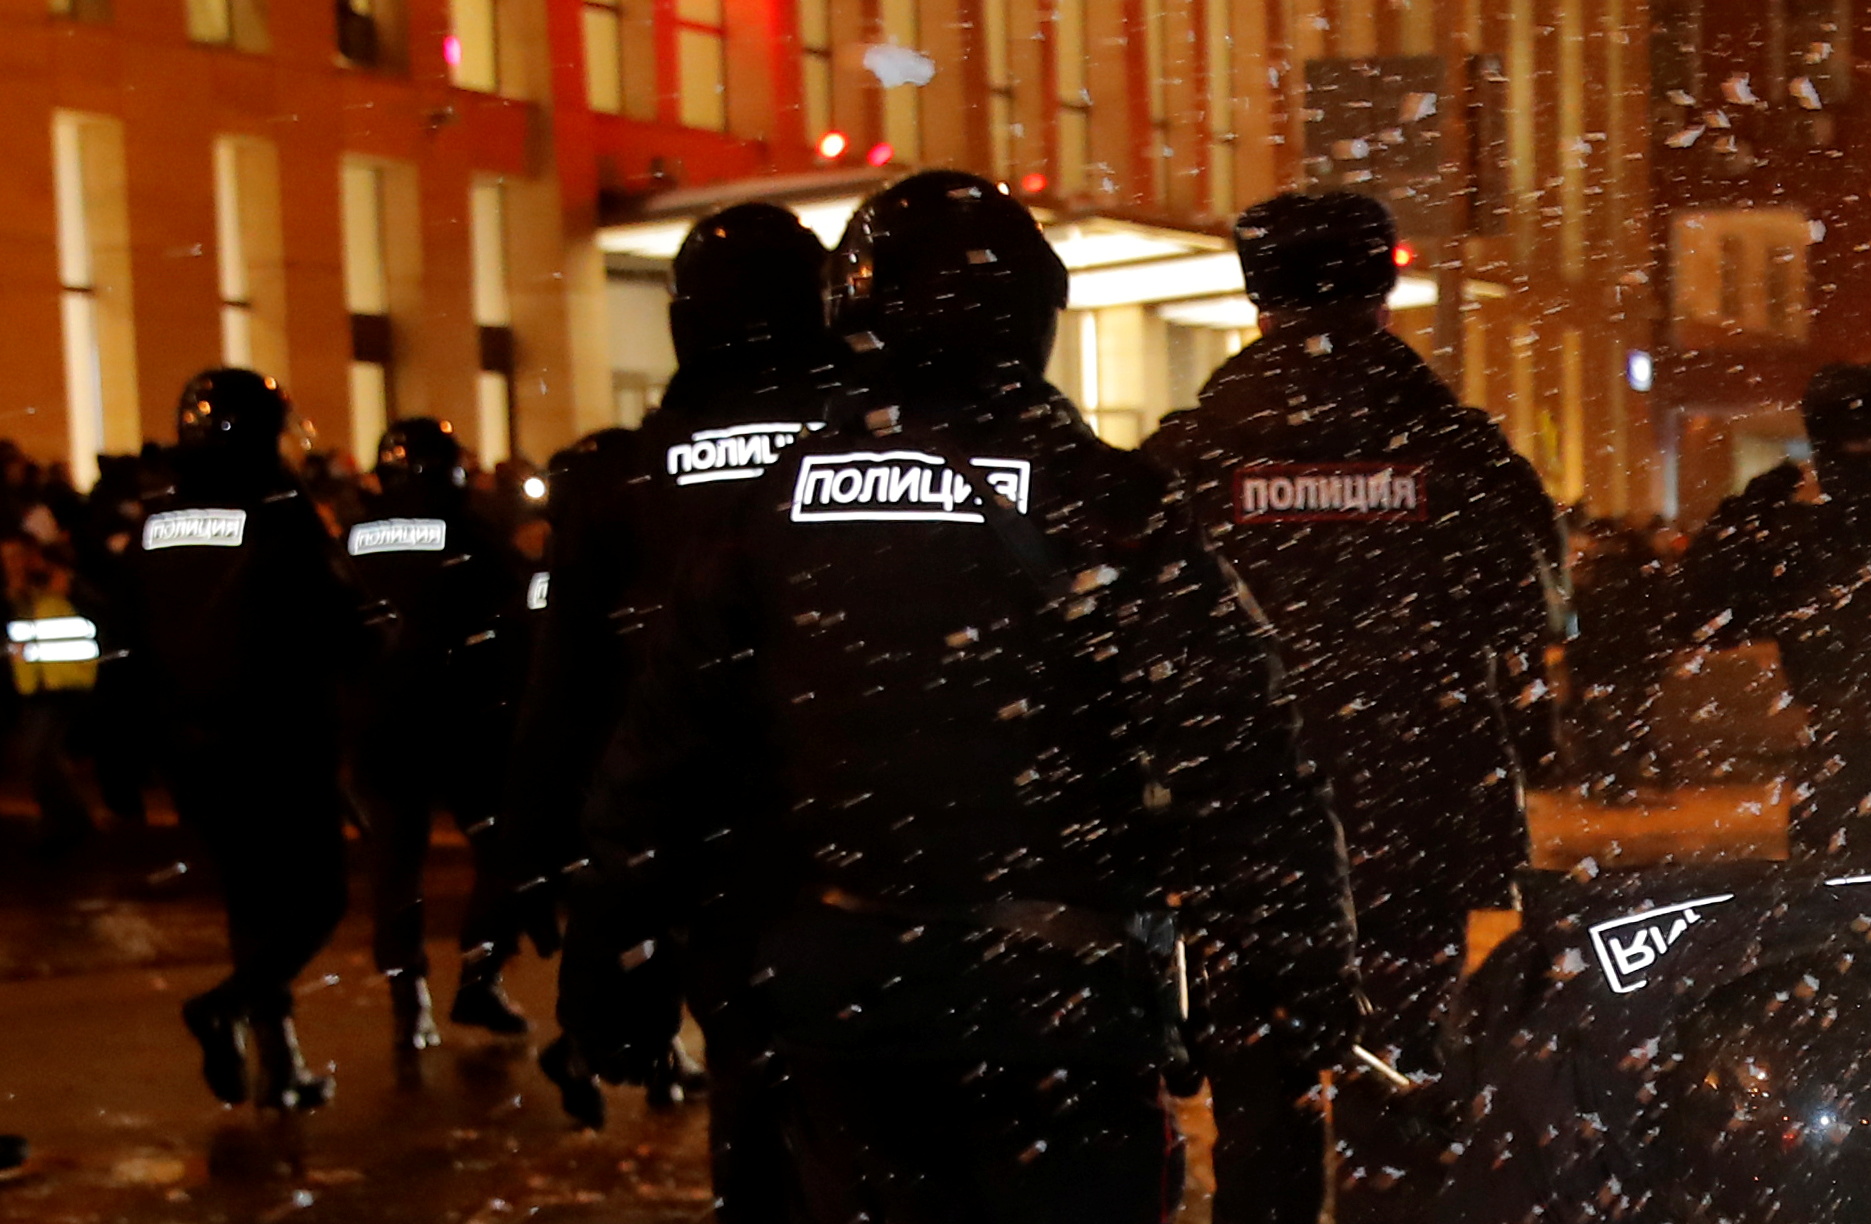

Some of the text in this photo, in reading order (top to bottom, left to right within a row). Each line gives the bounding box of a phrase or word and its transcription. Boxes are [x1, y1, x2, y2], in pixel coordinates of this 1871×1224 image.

[667, 434, 794, 475] ПОЛИЦ
[1243, 474, 1416, 512] ПОЛИЦИЯ
[153, 518, 240, 540] ПОЛИЦИЯ
[359, 525, 441, 546] ПОЛИЦИЯ
